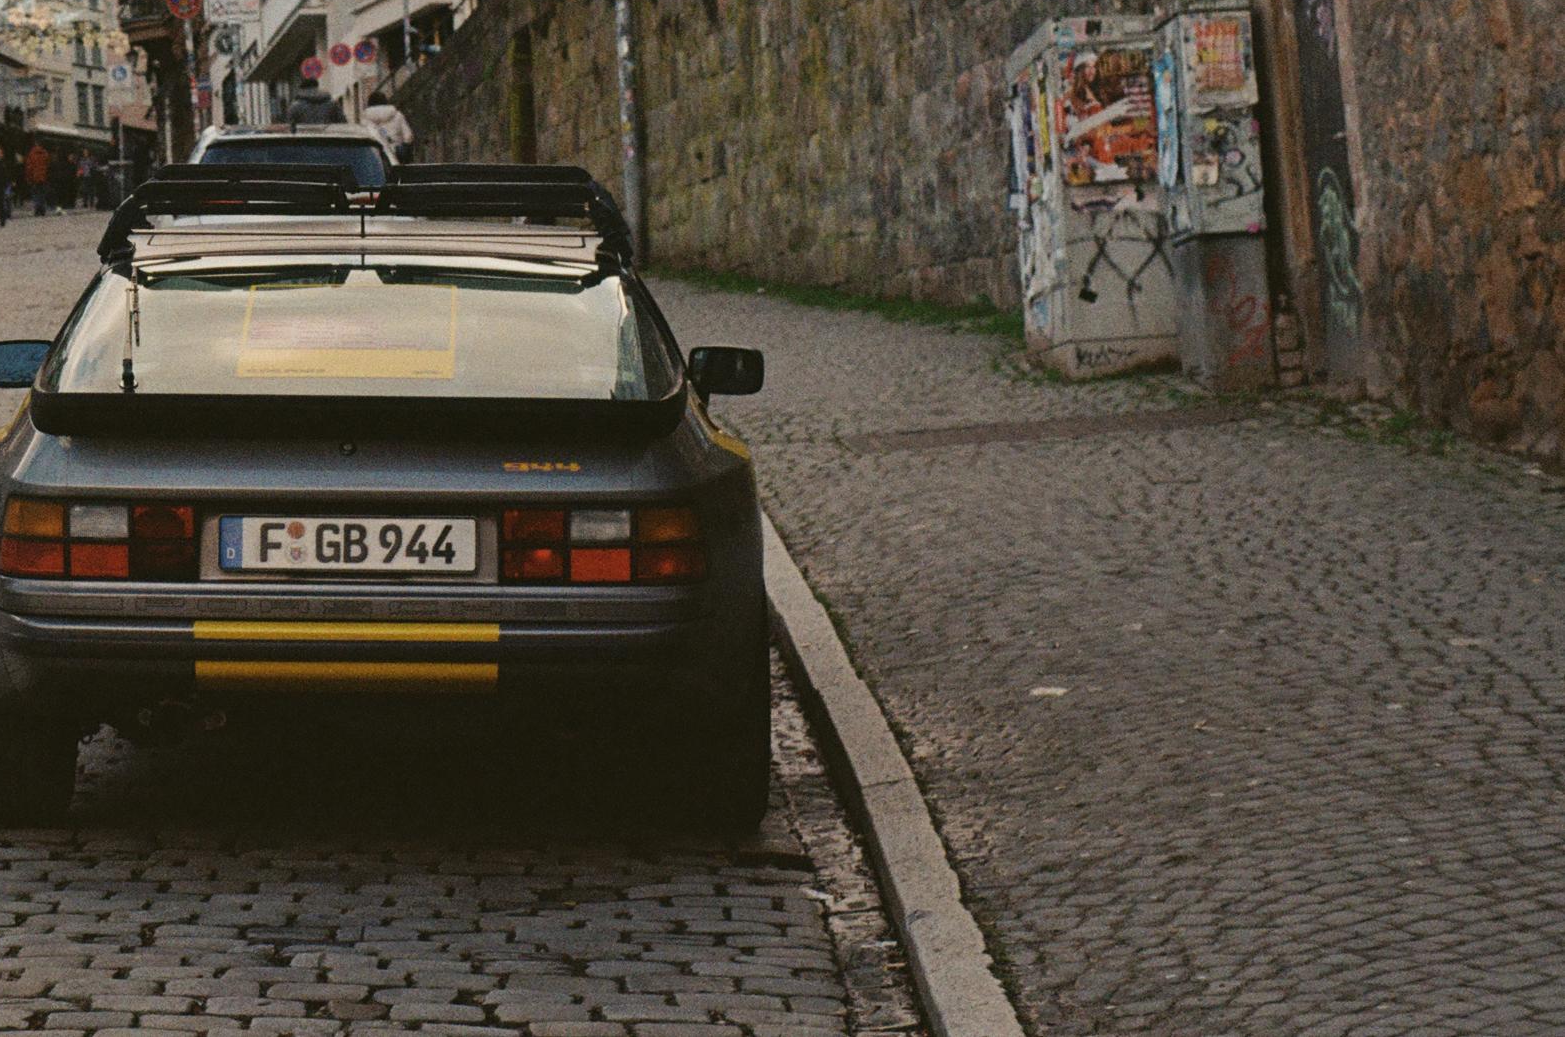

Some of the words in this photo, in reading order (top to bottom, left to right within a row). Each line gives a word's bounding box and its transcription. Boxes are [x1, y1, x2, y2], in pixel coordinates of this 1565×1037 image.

[226, 547, 235, 559] D
[260, 523, 286, 563] F
[315, 523, 369, 564] GB
[379, 524, 456, 564] 944
